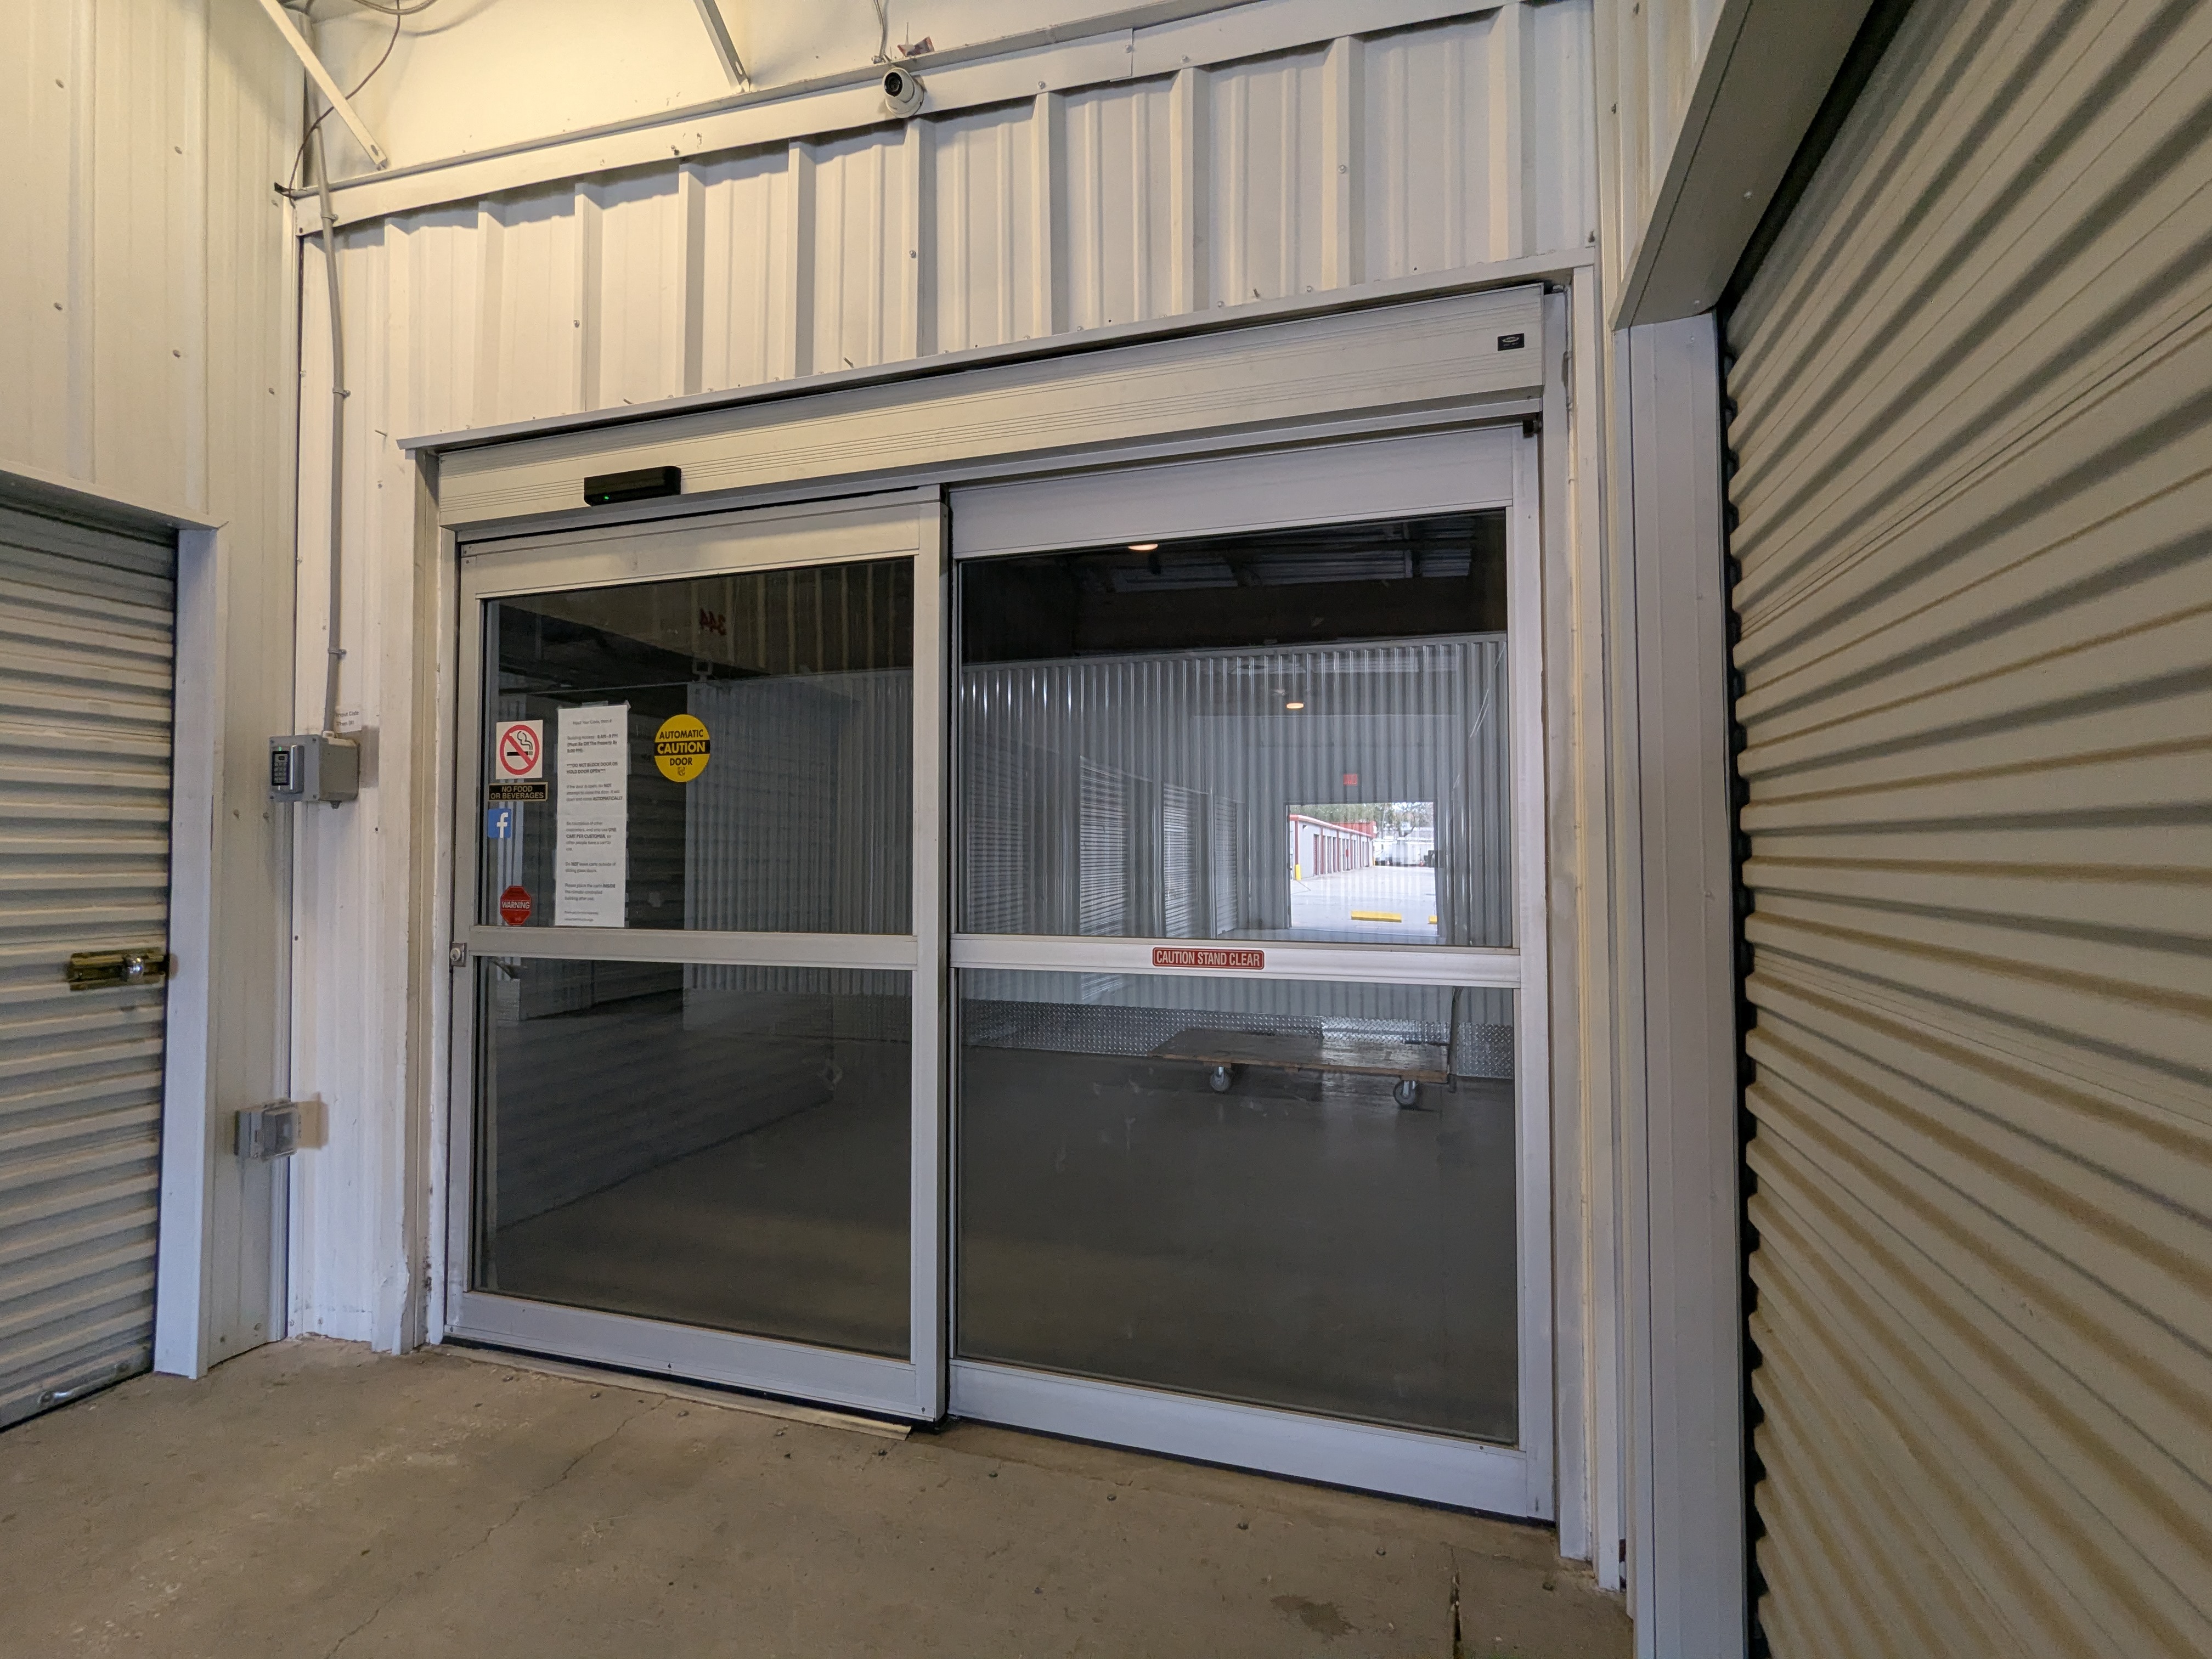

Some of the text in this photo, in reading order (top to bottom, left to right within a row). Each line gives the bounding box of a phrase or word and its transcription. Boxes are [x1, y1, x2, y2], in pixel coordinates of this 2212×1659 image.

[659, 729, 703, 740] AUTOMATIC
[657, 742, 706, 754] CAUTION
[670, 758, 692, 766] DOOR
[496, 812, 508, 838] f
[1156, 950, 1260, 966] CAUTION STAND CLEAR
